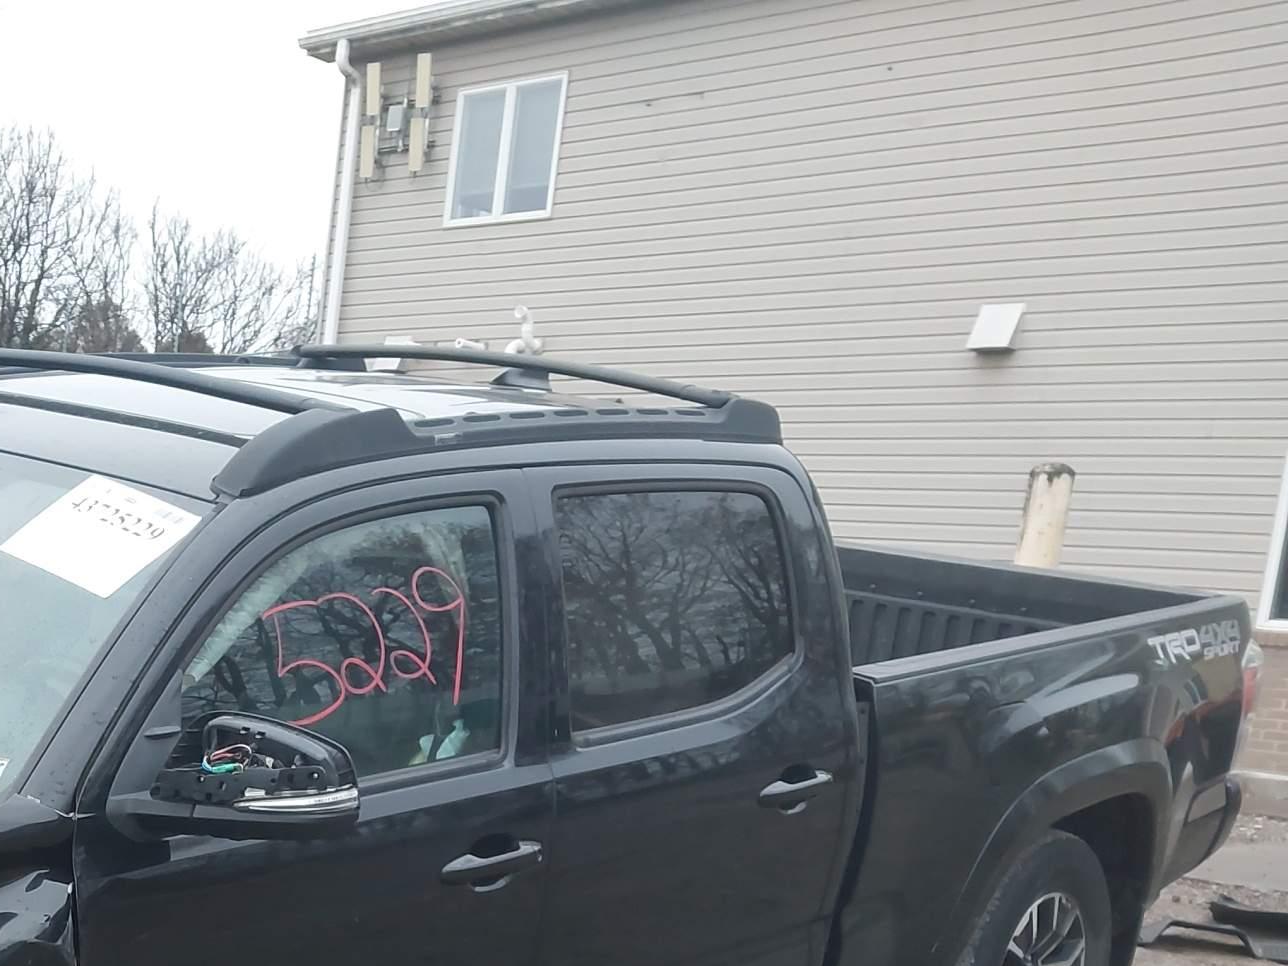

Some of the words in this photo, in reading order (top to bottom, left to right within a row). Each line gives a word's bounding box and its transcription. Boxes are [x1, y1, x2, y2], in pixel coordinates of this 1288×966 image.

[262, 566, 465, 726] 5229
[1147, 628, 1200, 664] TRD
[1203, 641, 1241, 660] SPORT
